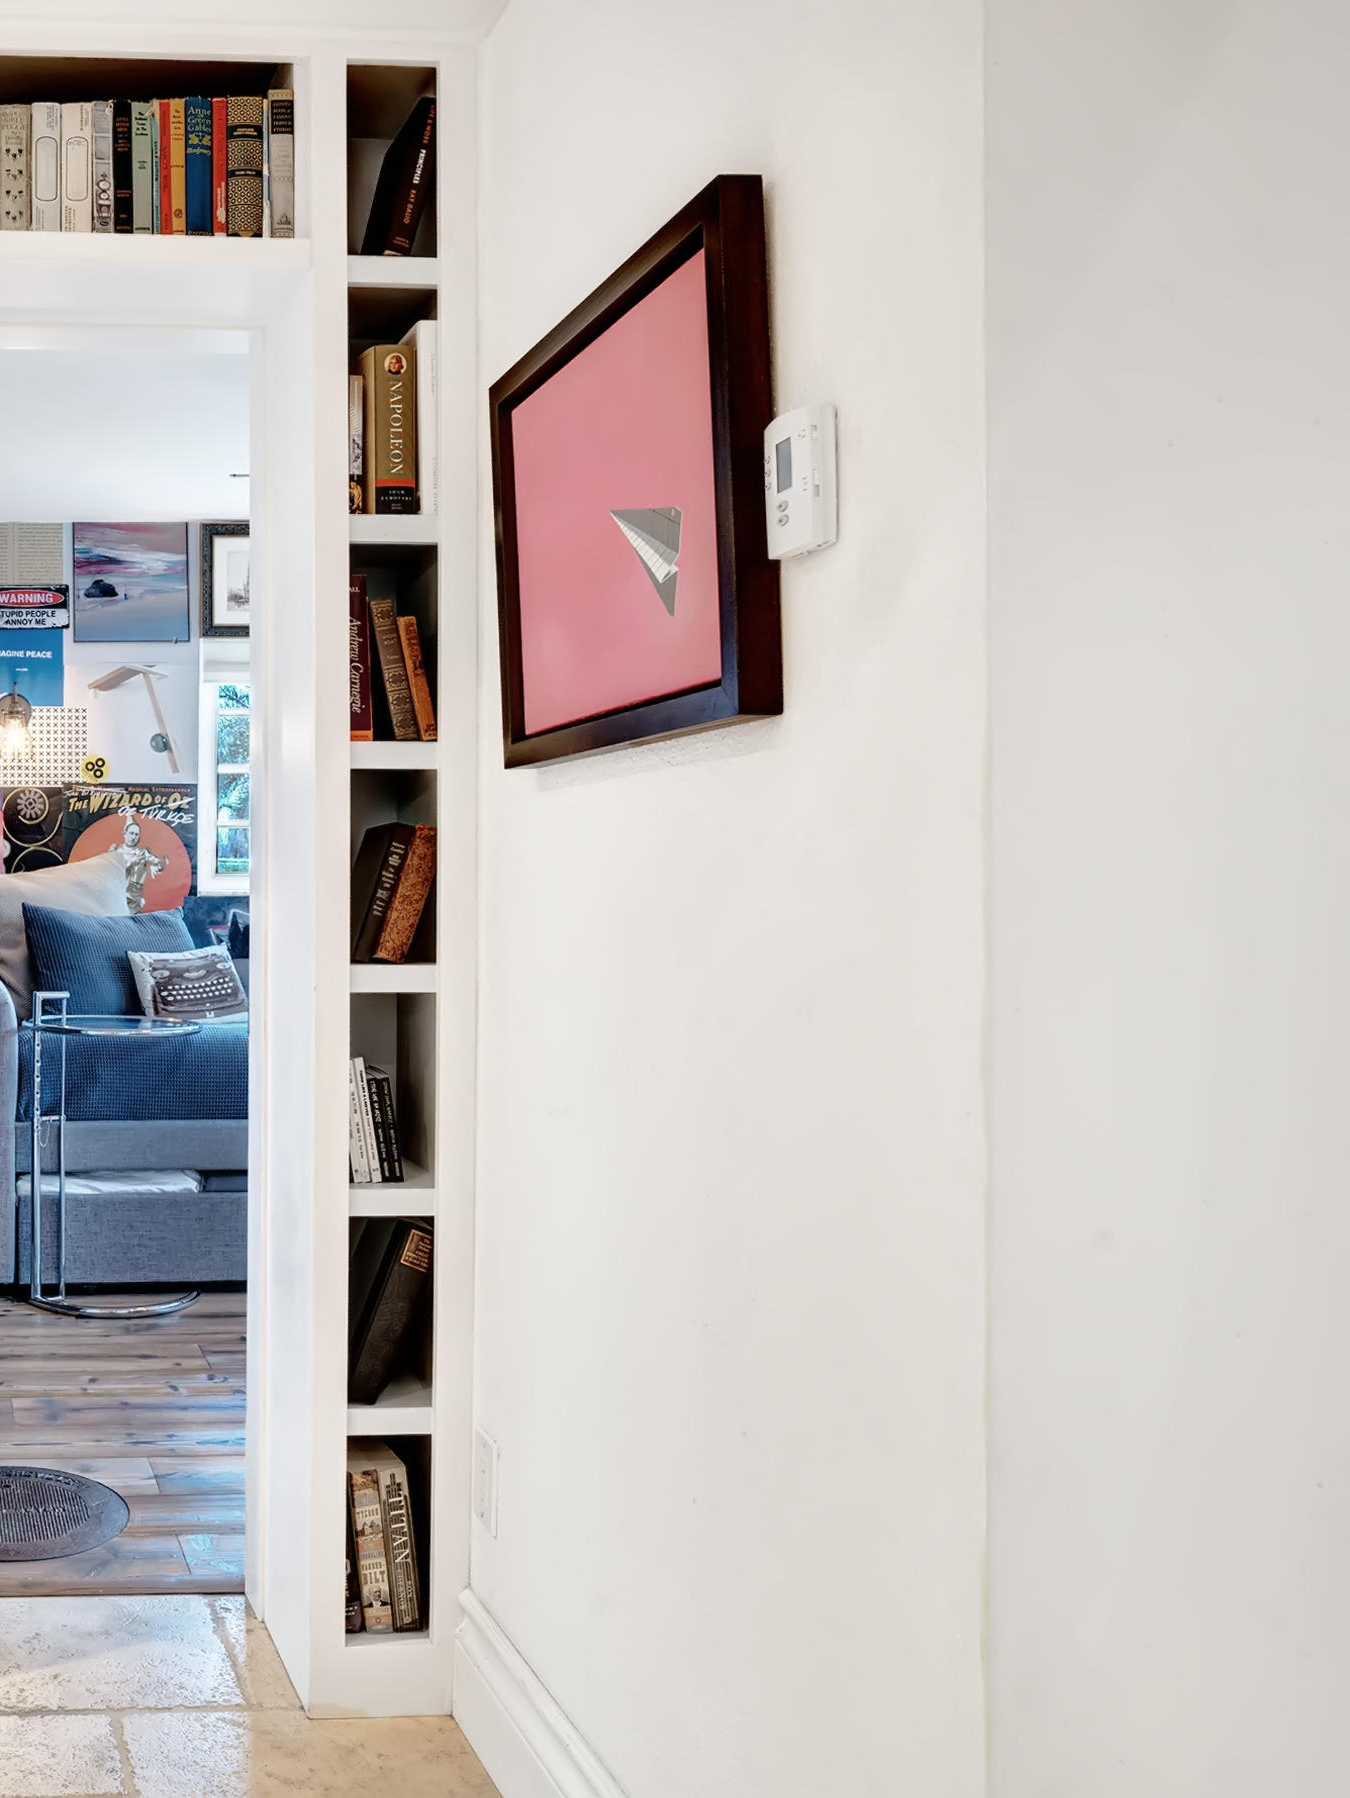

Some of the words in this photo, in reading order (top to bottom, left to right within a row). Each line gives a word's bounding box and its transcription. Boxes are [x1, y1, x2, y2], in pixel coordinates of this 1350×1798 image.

[188, 107, 211, 115] Anne
[413, 149, 426, 184] PRINCIPLES
[409, 189, 417, 202] RAY
[403, 203, 414, 224] DALIO
[389, 381, 403, 474] NAPOLEON
[5, 618, 33, 626] ANNOY
[35, 618, 46, 626] ME
[27, 610, 56, 618] PEOPLE
[350, 617, 362, 660] Andrew
[350, 662, 365, 713] Carnegie
[90, 792, 152, 813] WIZARD
[155, 795, 167, 804] OF
[357, 1508, 379, 1520] TYCOON
[388, 1493, 410, 1564] TITAN
[363, 1571, 386, 1585] BILT
